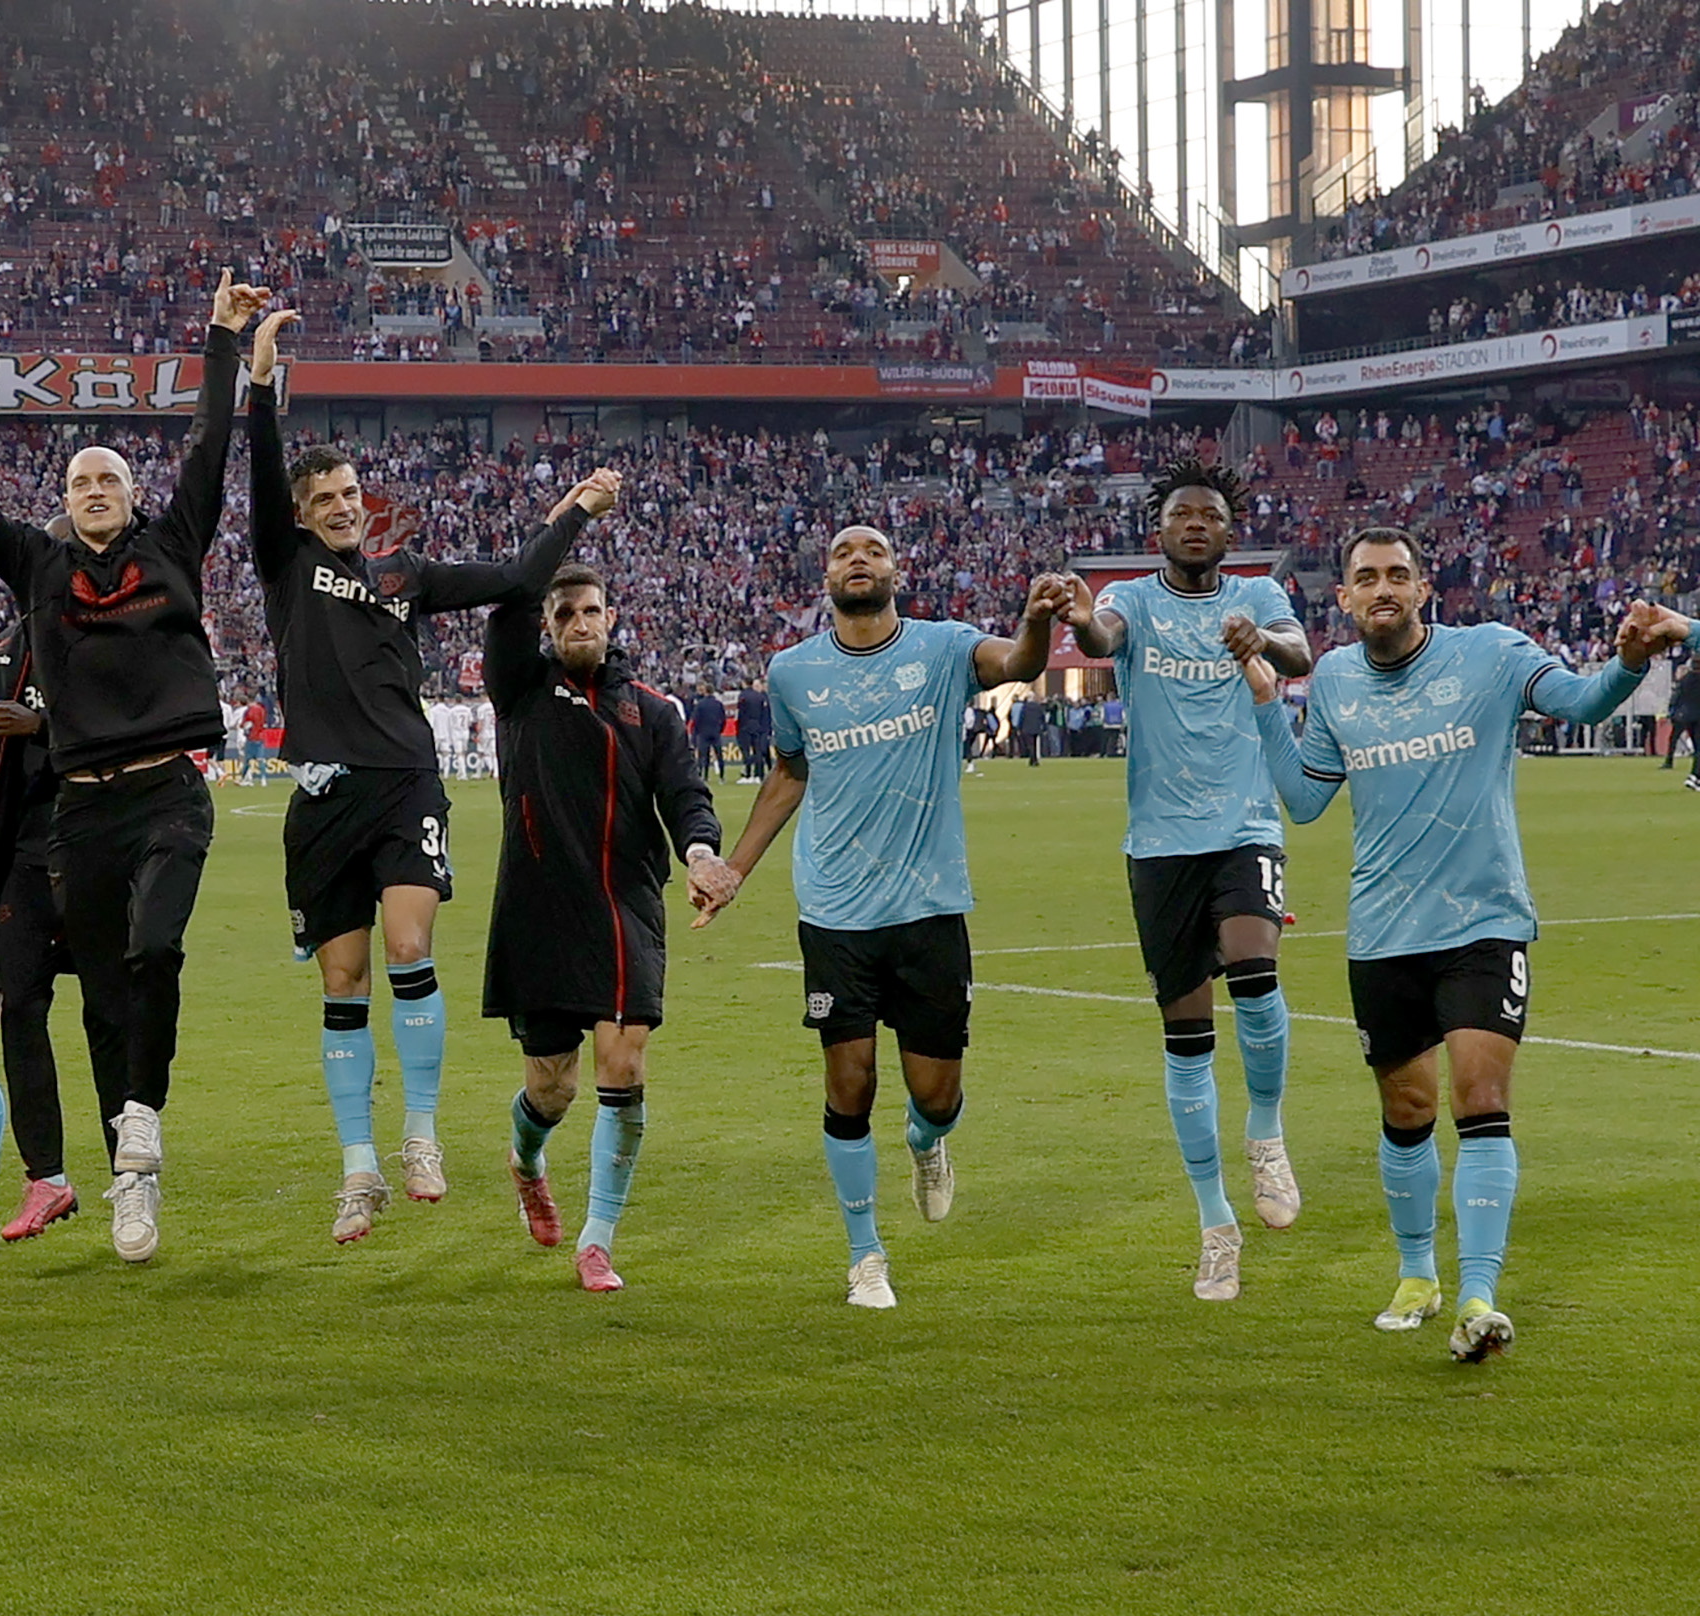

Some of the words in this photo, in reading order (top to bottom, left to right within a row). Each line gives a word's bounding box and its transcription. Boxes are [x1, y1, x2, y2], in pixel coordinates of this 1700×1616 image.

[1027, 360, 1077, 376] COLONIA
[1361, 346, 1489, 382] RheinEnergieSTADION
[461, 659, 481, 674] FC
[807, 703, 936, 753] Barmenia
[1341, 723, 1476, 772] Barmenia
[421, 816, 448, 857] 3
[1510, 951, 1527, 998] 9
